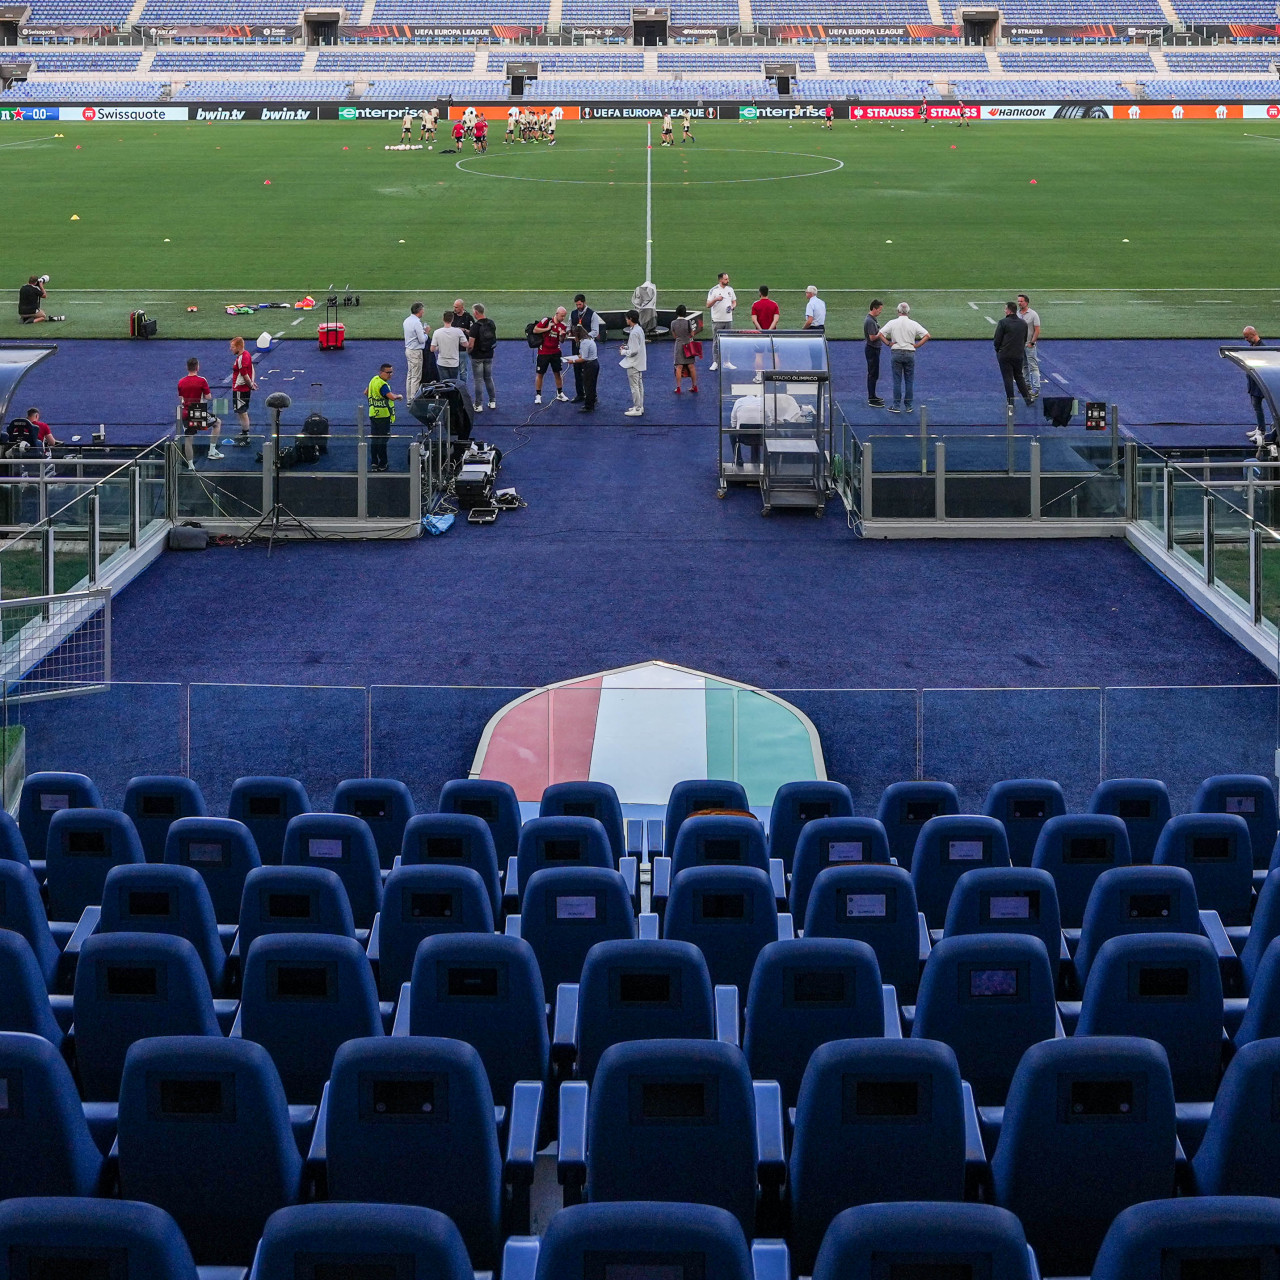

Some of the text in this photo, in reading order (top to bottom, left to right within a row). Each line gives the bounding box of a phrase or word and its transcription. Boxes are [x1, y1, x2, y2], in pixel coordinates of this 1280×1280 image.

[97, 108, 166, 120] Swissquote
[196, 107, 246, 120] bwin.tv
[261, 107, 310, 120] bwin.tv
[593, 108, 621, 118] UEFA
[623, 108, 662, 118] EUROPA
[867, 108, 914, 117] STRAUSS
